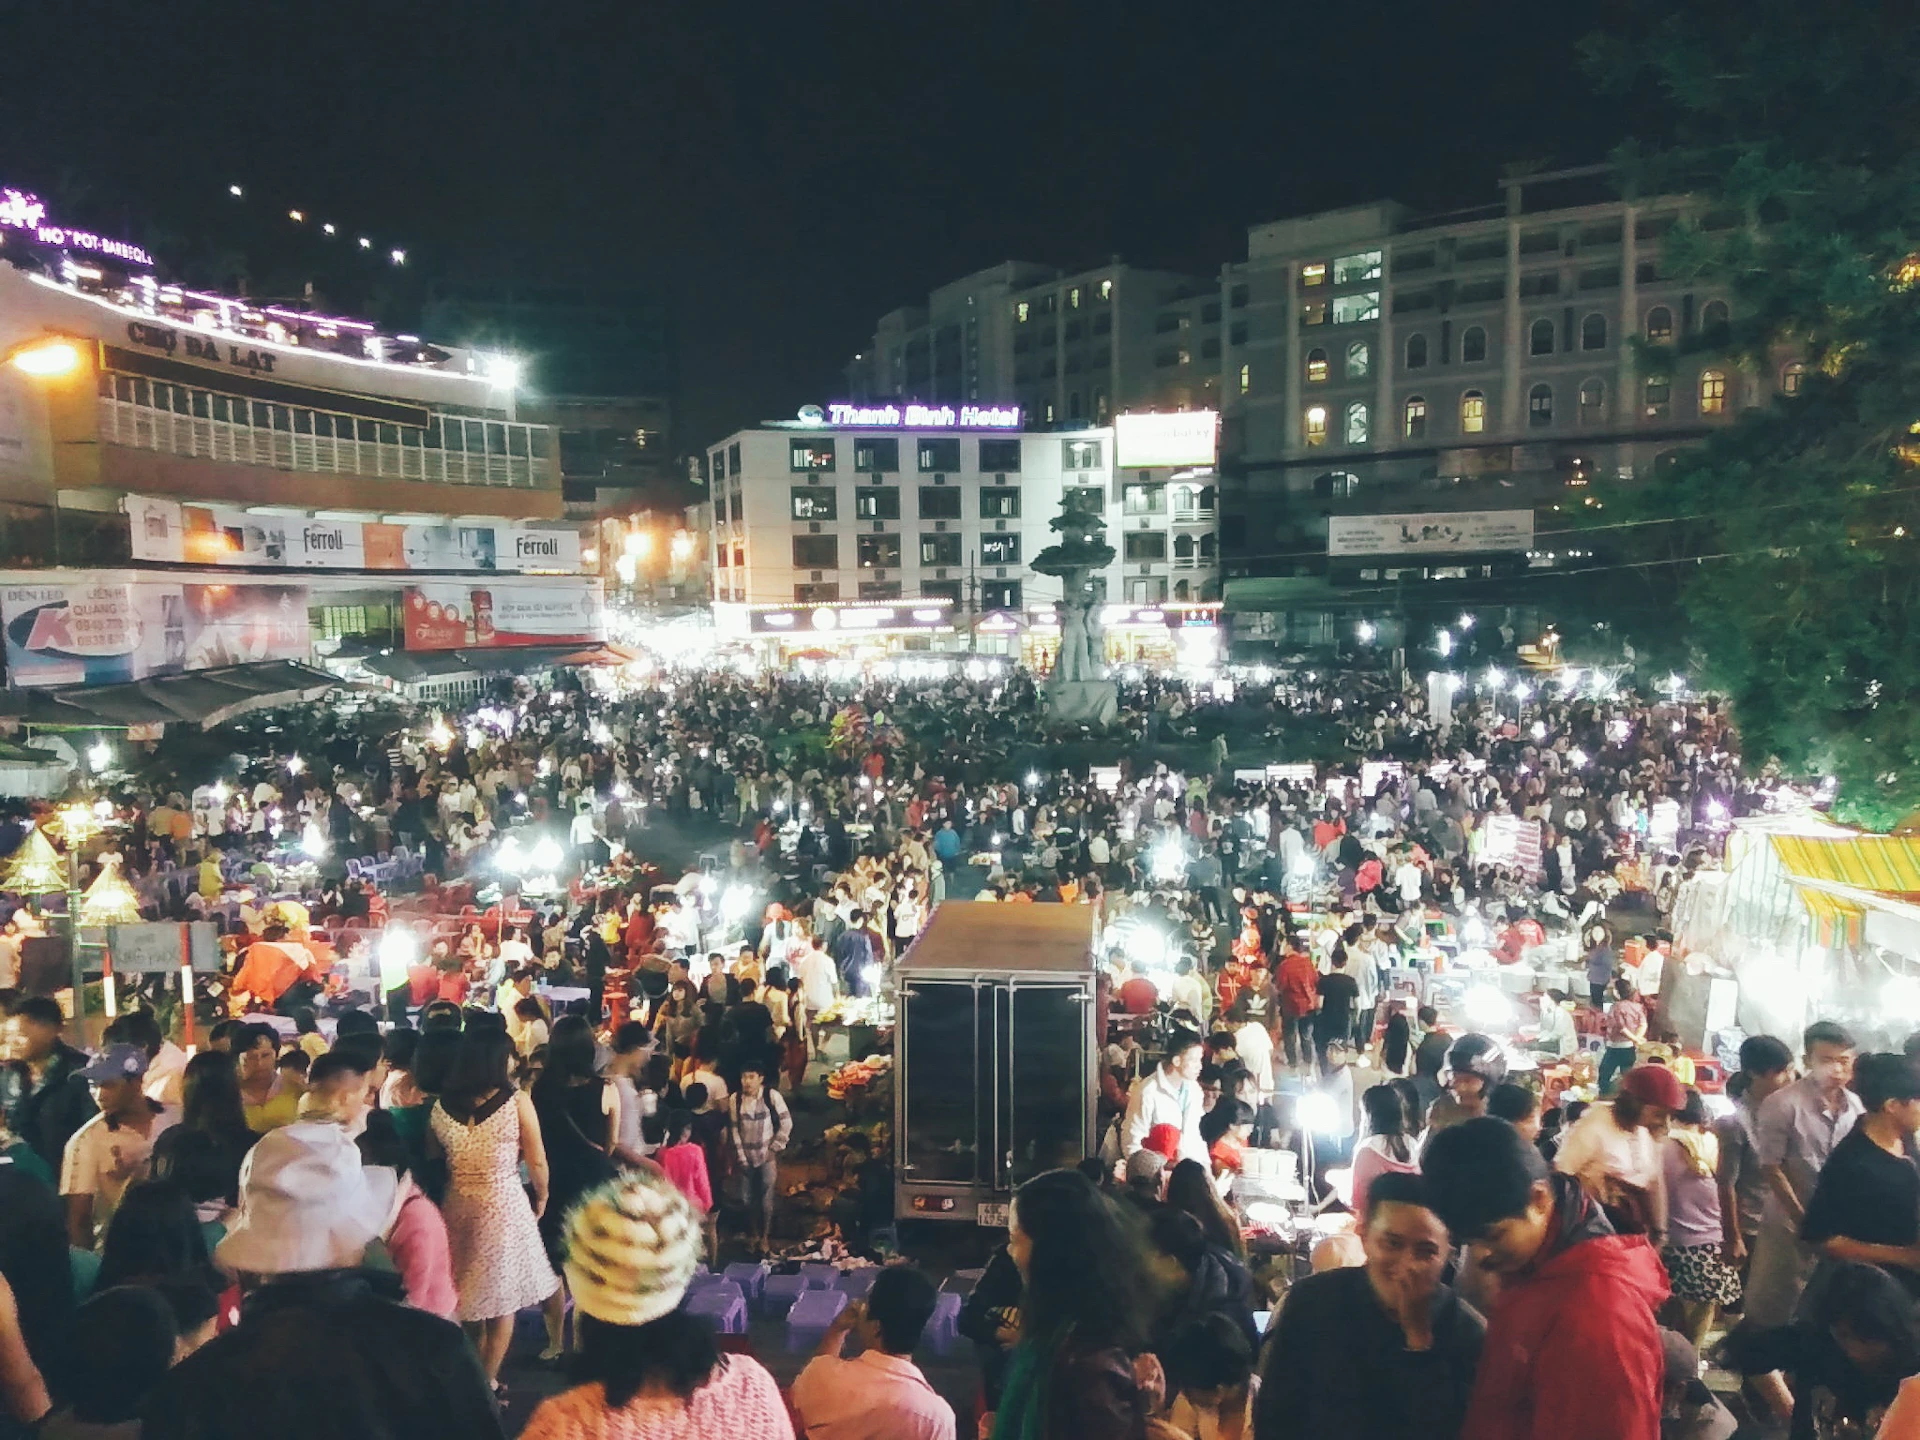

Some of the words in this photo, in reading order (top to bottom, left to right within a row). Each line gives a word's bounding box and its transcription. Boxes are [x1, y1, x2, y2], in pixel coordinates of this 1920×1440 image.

[960, 406, 1019, 426] Hotel
[303, 527, 344, 552] Ferroli
[516, 537, 558, 557] Ferroli
